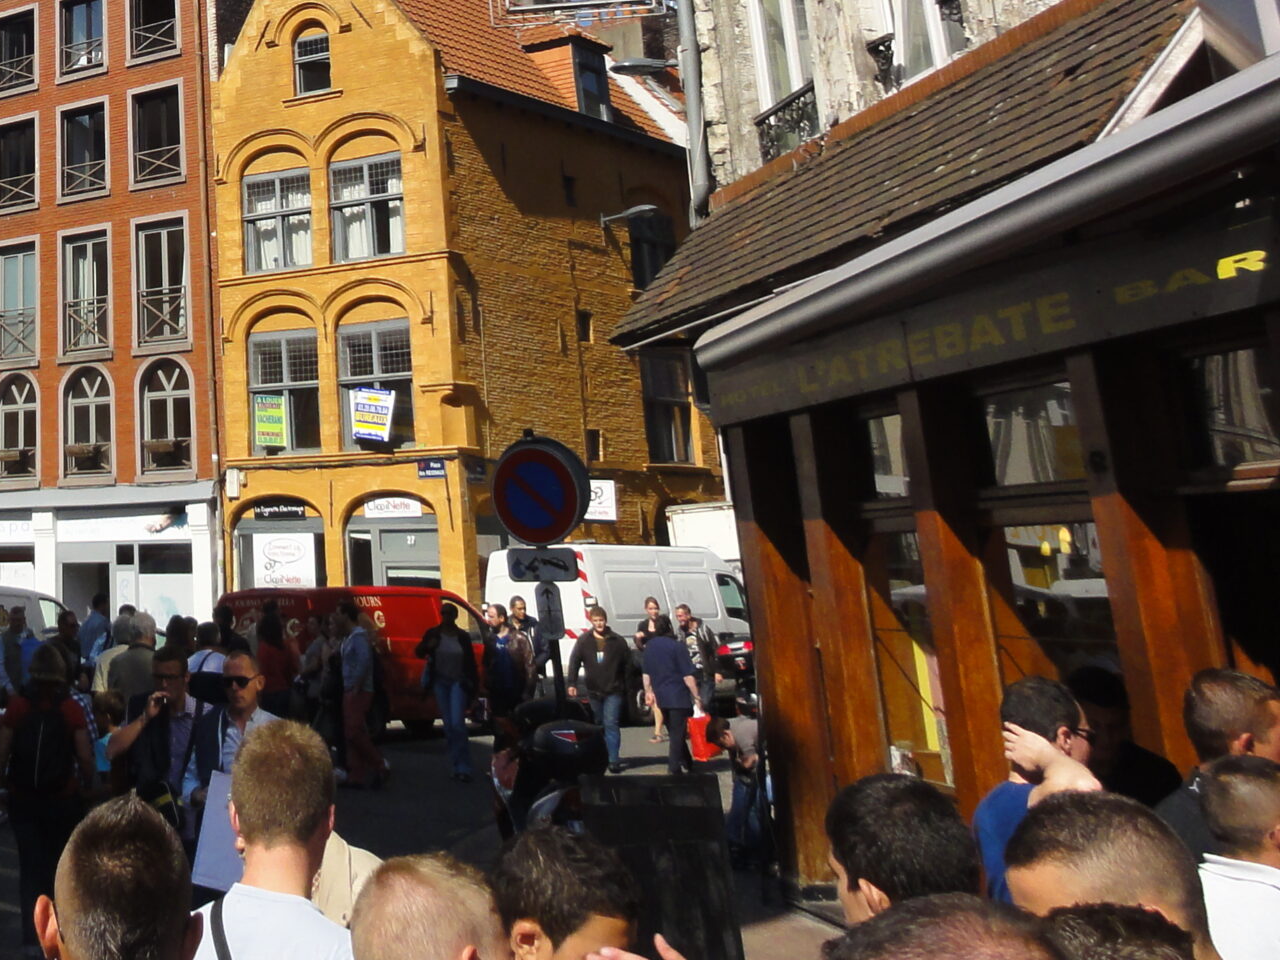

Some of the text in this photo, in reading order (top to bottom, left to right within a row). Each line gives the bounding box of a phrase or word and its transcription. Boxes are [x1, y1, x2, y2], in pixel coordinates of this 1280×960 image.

[722, 249, 1268, 408] HOTEL L'ATREBATE BAR
[0, 521, 30, 536] spa
[406, 534, 416, 545] 27
